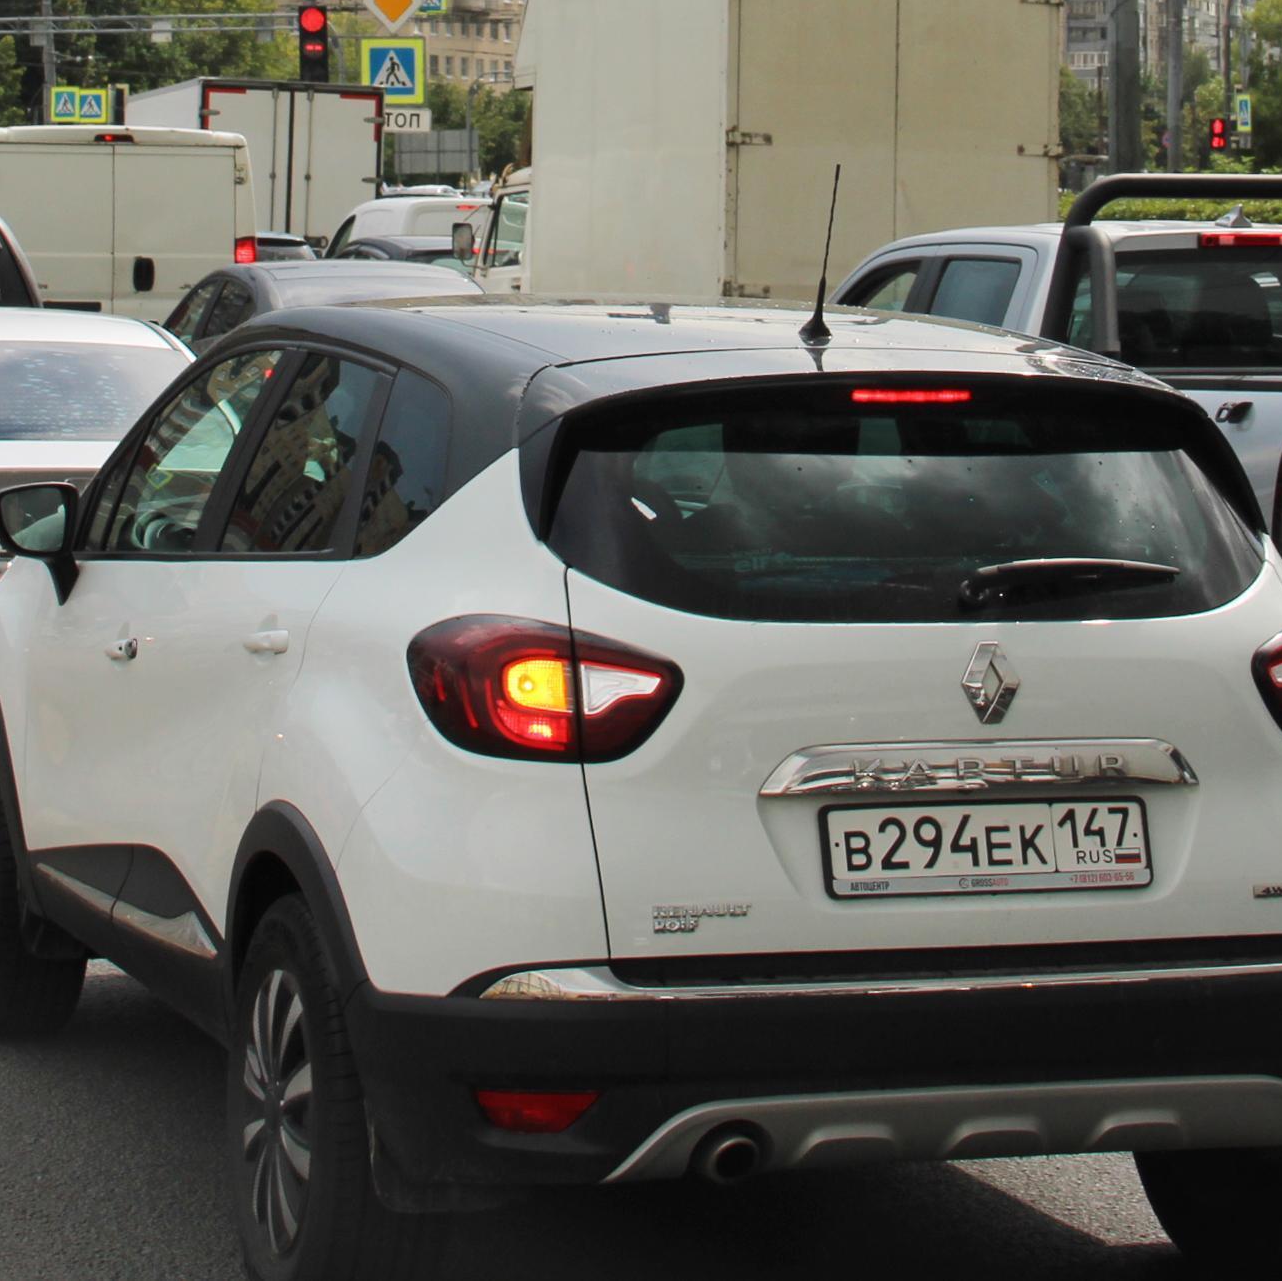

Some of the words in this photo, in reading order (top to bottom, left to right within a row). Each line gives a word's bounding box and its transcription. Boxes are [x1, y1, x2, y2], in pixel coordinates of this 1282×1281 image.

[384, 112, 420, 128] ТОП
[852, 753, 1128, 781] KAPTUR
[843, 814, 1048, 871] В294ЕК
[1057, 806, 1130, 849] 147
[1076, 849, 1114, 864] RUS
[850, 881, 890, 892] АВТОЦЕНТР
[970, 877, 1009, 888] GROSSAUTO
[653, 903, 751, 917] RENAULT
